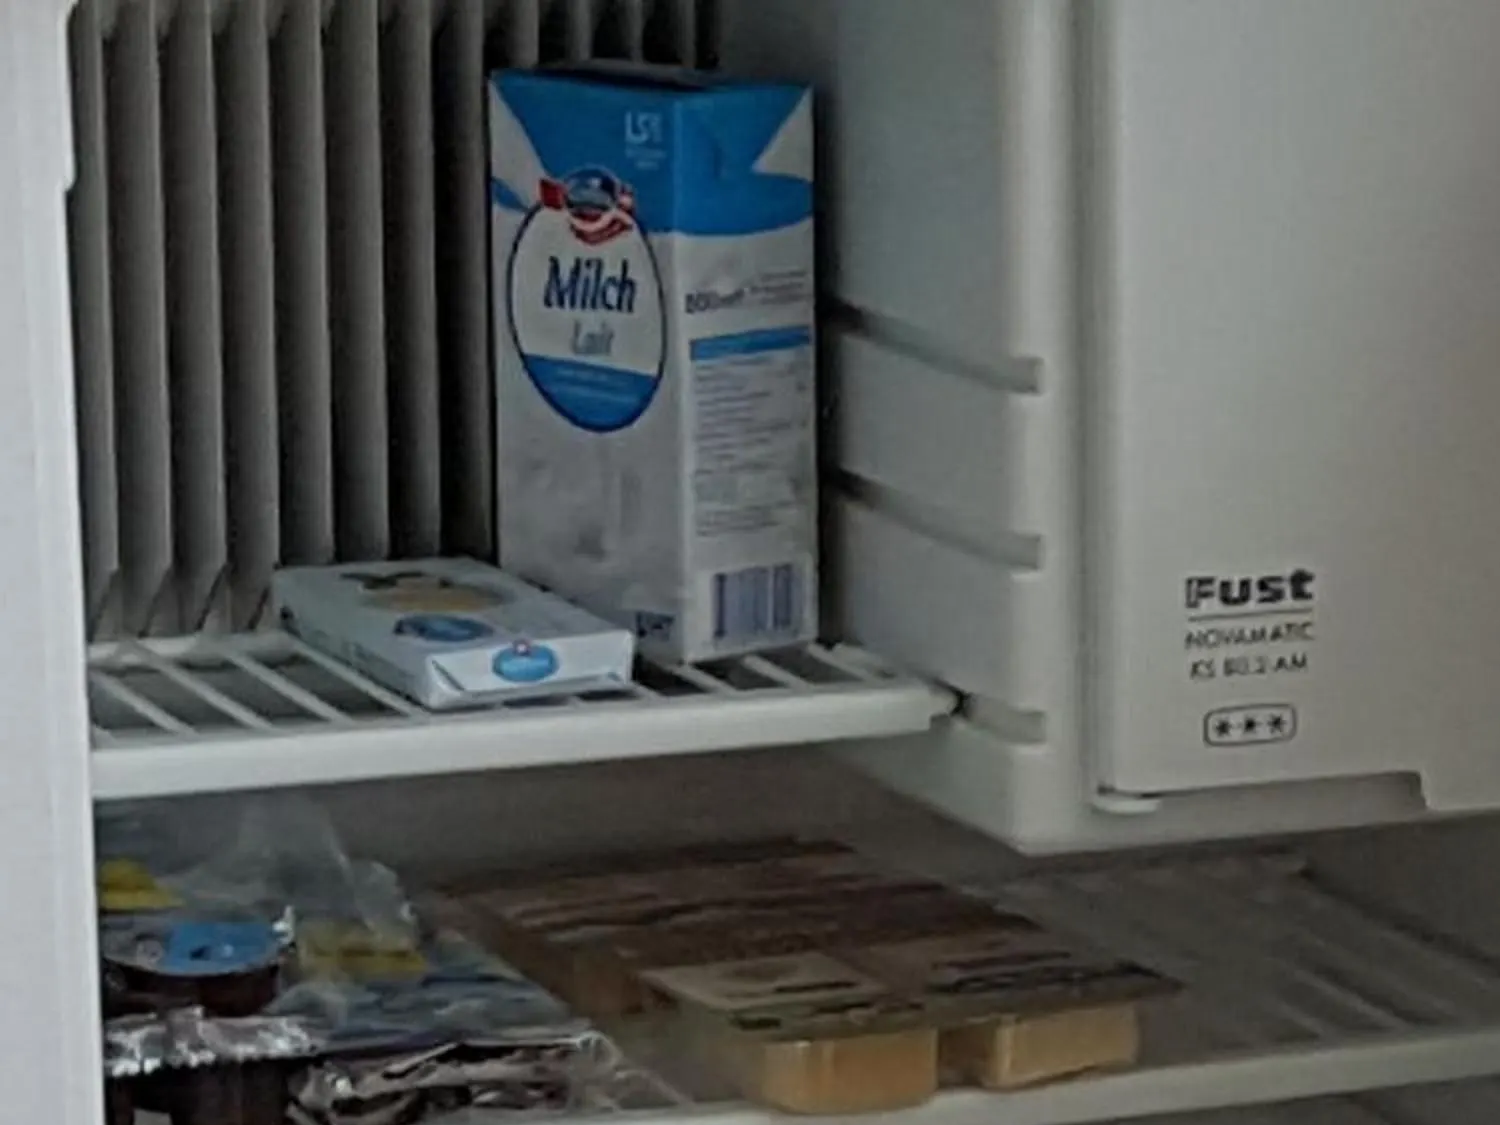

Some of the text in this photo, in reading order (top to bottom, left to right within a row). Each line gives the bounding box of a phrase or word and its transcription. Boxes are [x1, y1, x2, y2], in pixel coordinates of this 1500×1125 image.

[543, 255, 636, 313] Milch
[571, 320, 615, 355] Lait
[1185, 568, 1315, 608] Fust
